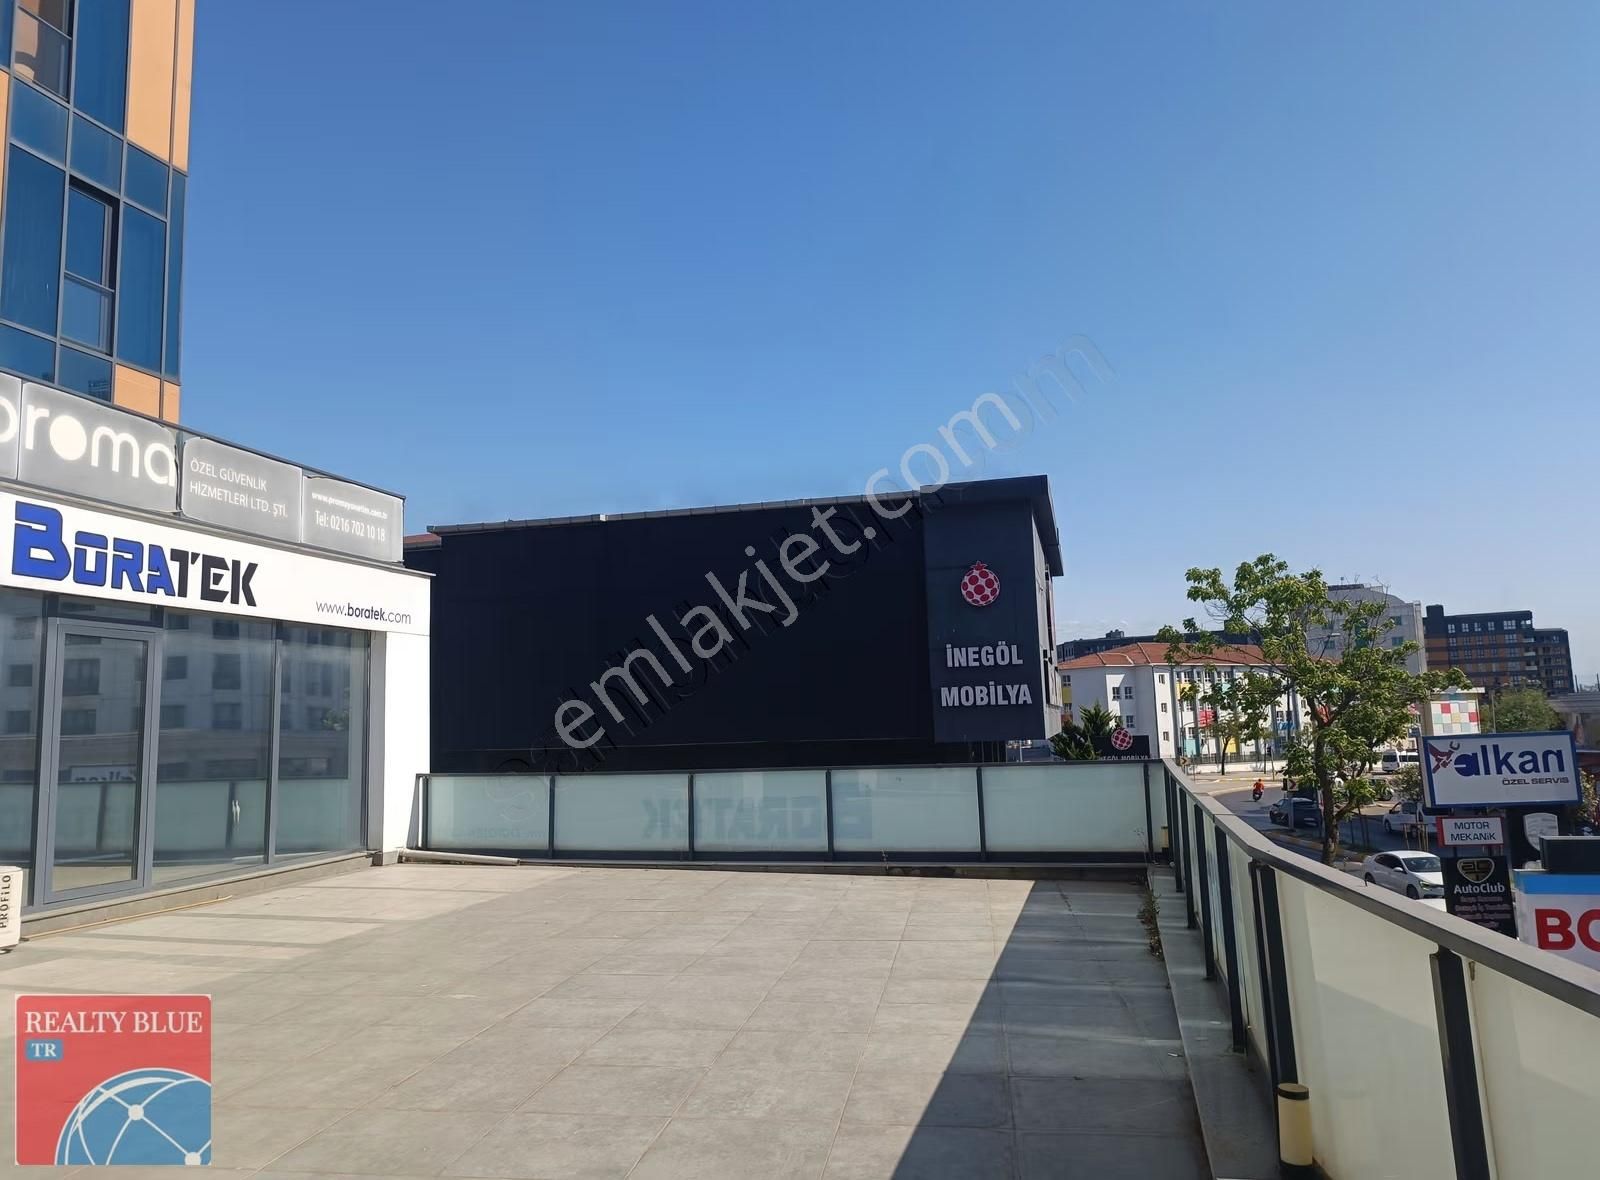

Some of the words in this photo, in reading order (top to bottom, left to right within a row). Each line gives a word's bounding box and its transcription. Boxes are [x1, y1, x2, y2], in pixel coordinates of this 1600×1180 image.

[190, 457, 217, 478] ÖZEL
[219, 465, 268, 492] GÜVENLİK
[189, 480, 249, 509] HİZMETLERİ
[250, 493, 271, 514] LTD.
[272, 500, 288, 519] ŞTİ.
[315, 510, 329, 528] Tel:
[330, 515, 350, 533] 0216
[351, 520, 365, 537] 702
[367, 525, 375, 539] 10
[12, 501, 259, 607] BORATEK
[315, 599, 412, 625] www.boratek.com
[945, 640, 1024, 668] İNEGÖL
[940, 680, 1033, 707] MOBİLYA
[1453, 743, 1565, 777] alkan
[1502, 777, 1530, 786] ÖZEL
[1454, 821, 1490, 830] MOTOR
[1453, 882, 1506, 894] AutoClub
